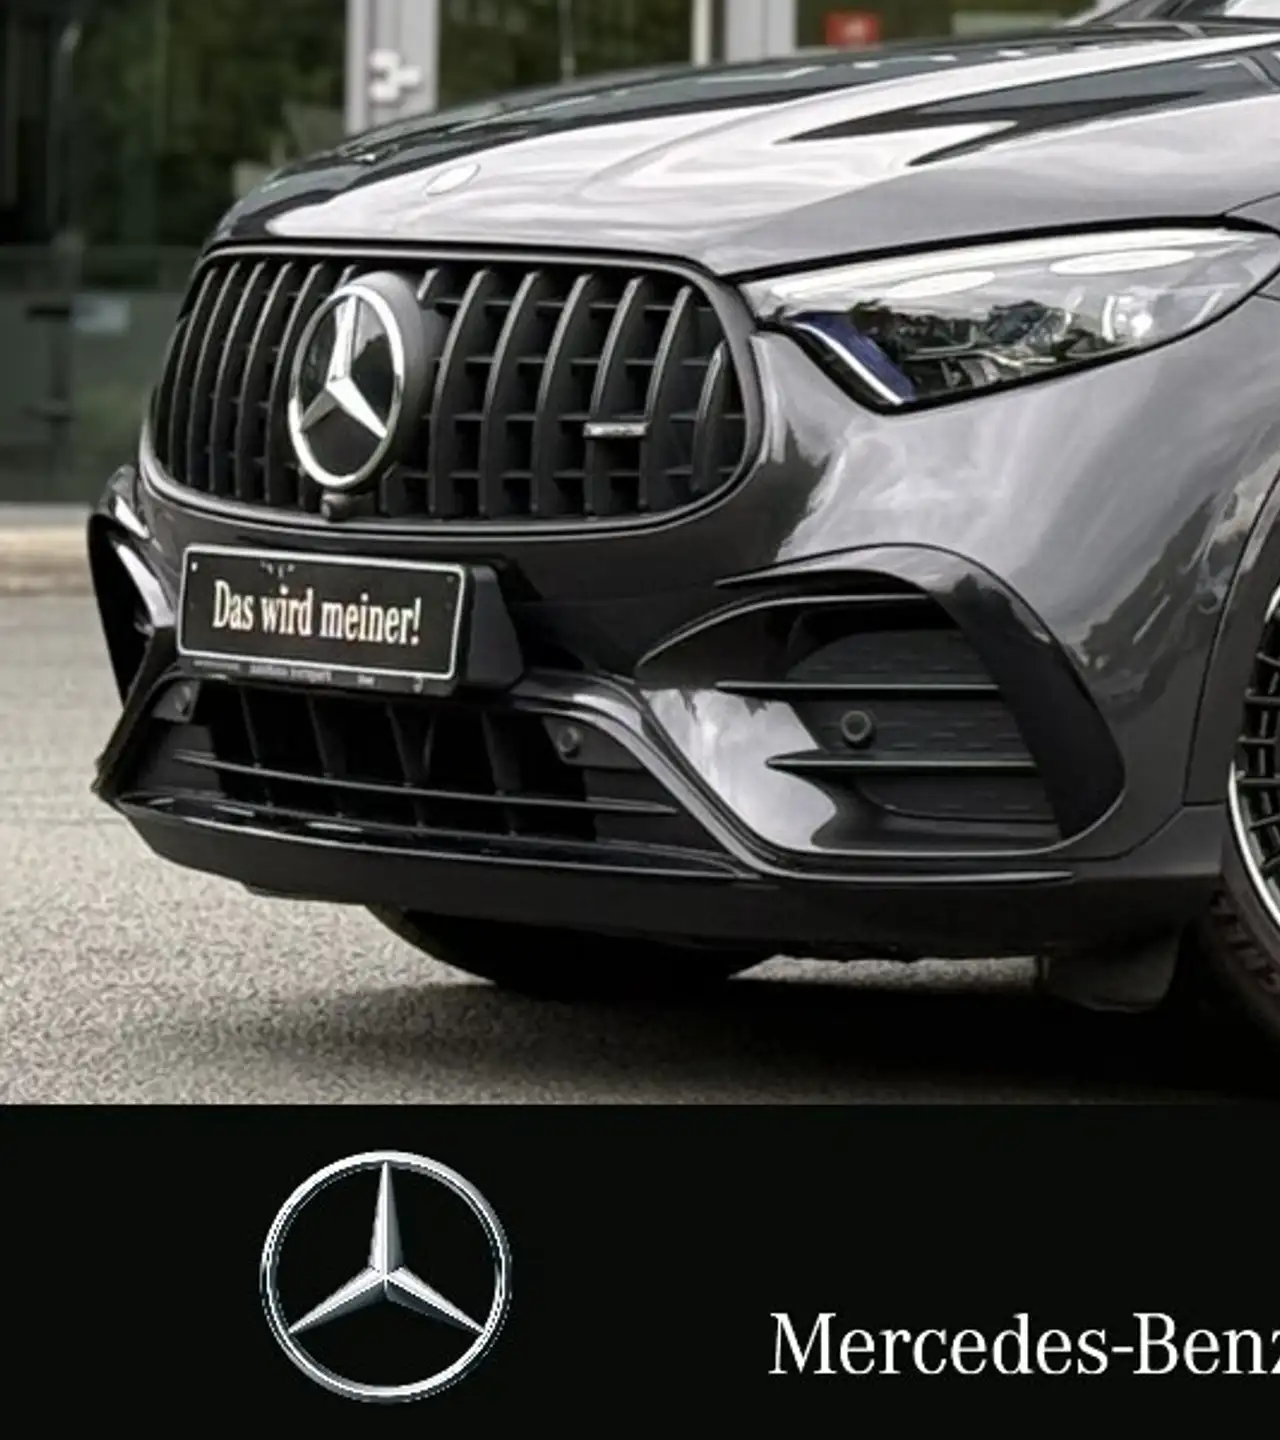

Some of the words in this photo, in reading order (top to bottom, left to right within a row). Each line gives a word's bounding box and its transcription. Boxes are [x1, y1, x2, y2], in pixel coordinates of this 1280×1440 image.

[213, 579, 254, 629] Das
[261, 584, 313, 638] wird
[320, 593, 422, 647] meiner!
